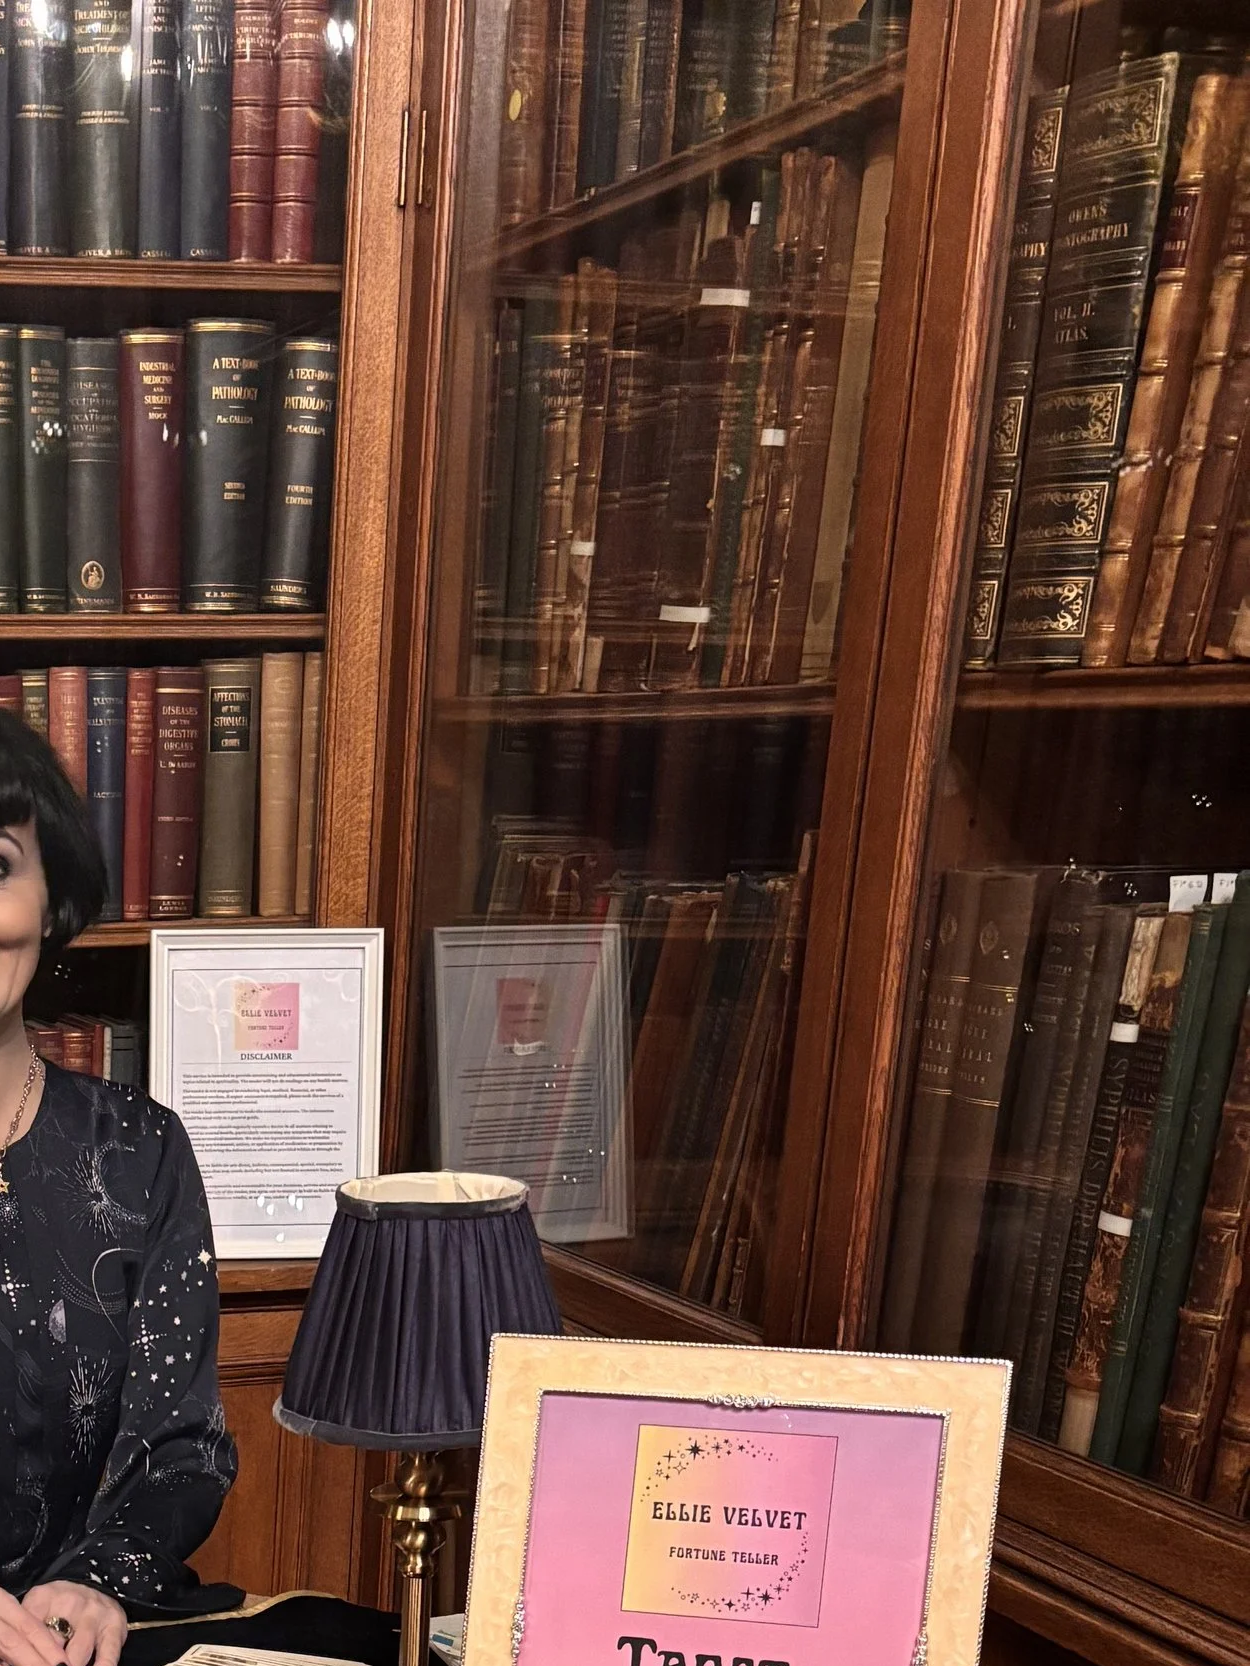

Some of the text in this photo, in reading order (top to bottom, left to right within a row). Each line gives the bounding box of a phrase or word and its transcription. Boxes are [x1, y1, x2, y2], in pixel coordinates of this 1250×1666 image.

[240, 1008, 292, 1018] ELLIE VELVET
[240, 1052, 293, 1061] DISCLAIMER
[652, 1501, 807, 1530] ELLIE VELVET
[669, 1546, 779, 1566] FORTUNE TELLER
